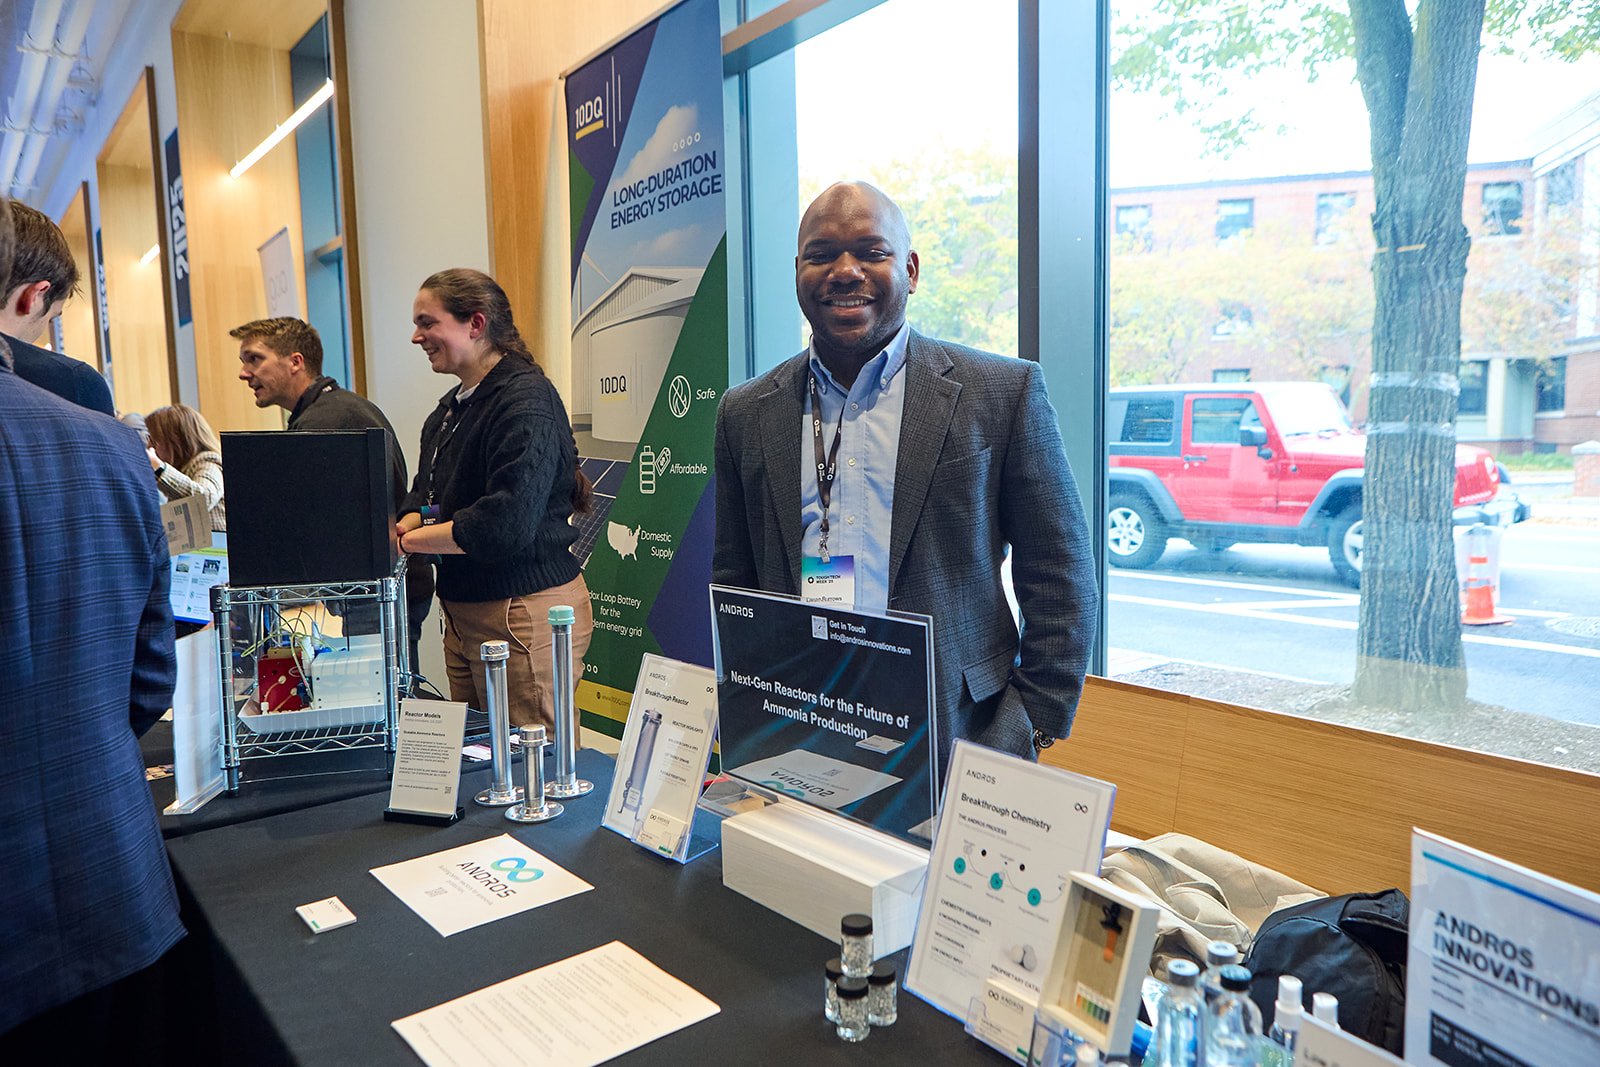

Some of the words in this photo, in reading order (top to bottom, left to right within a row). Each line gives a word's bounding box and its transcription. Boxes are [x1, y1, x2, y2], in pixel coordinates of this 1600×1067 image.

[575, 96, 603, 129] 10DQ
[613, 151, 717, 207] LONG-DURATION
[611, 198, 655, 229] ENERGY
[658, 174, 722, 212] STORAGE
[600, 375, 627, 394] 10DQ
[696, 388, 716, 400] Safe
[669, 463, 708, 474] Affordable
[640, 530, 672, 542] Domestic
[650, 547, 674, 560] Supply
[589, 591, 600, 601] dox
[600, 592, 616, 605] Loop
[617, 594, 642, 609] Battery
[600, 605, 611, 616] for
[611, 606, 621, 618] the
[719, 603, 754, 618] ANDROS
[592, 618, 606, 629] dern
[606, 622, 628, 636] energy
[628, 626, 643, 637] grid
[829, 620, 840, 630] Get
[847, 623, 867, 634] Touch
[645, 688, 672, 701] Breakthrough
[673, 696, 690, 706] Reactor
[730, 670, 772, 692] Next-Gen
[774, 681, 817, 704] Reactors
[819, 693, 835, 709] for
[837, 697, 854, 714] the
[856, 703, 894, 725] Future
[896, 715, 909, 729] of
[762, 699, 809, 722] Ammonia
[810, 711, 868, 740] Production
[966, 769, 997, 785] ANDROS
[961, 793, 1010, 819] Breakthrough
[1011, 810, 1052, 833] Chemistry
[456, 861, 517, 899] ANDROS
[1435, 911, 1534, 969] ANDROS
[1433, 933, 1600, 1027] INNOVATIONS
